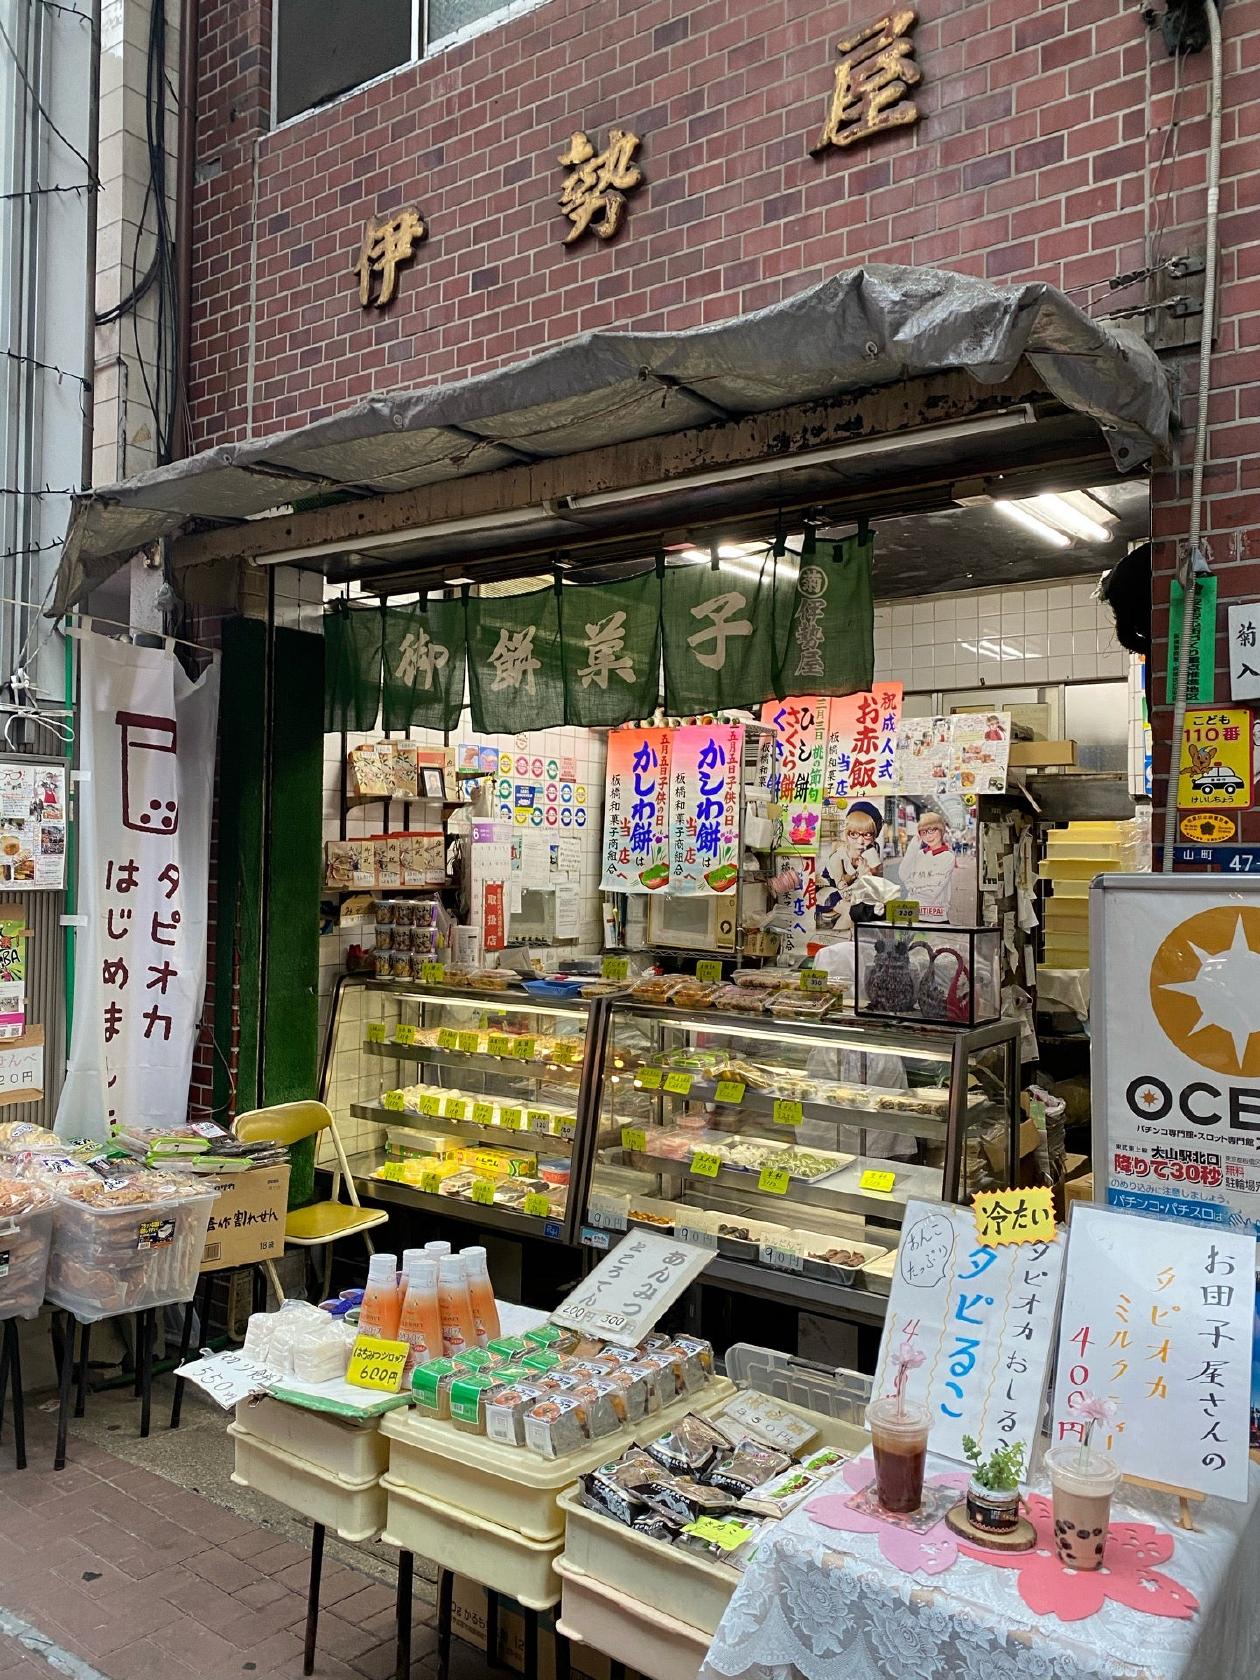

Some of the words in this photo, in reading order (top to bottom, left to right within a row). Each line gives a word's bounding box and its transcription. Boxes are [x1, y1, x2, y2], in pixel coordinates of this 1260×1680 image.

[879, 692, 897, 780] 祝成人式
[1183, 726, 1241, 742] 110番
[1193, 715, 1231, 726] こども
[1191, 796, 1234, 804] けいしちょう
[1173, 849, 1213, 860] 山町
[142, 862, 181, 1042] タピオカ
[102, 859, 141, 1138] はじめま
[1114, 1153, 1224, 1187] 降りて30秒
[907, 1224, 943, 1251] あんこ
[981, 1199, 1050, 1236] 冷たい
[578, 1241, 647, 1307] ところてん
[621, 1251, 688, 1316] あんみつ
[940, 1247, 998, 1418] タピるこ
[1144, 1267, 1181, 1399] タピオカ
[1186, 1245, 1236, 1471] お団子屋さんの
[360, 1366, 398, 1385] 600円
